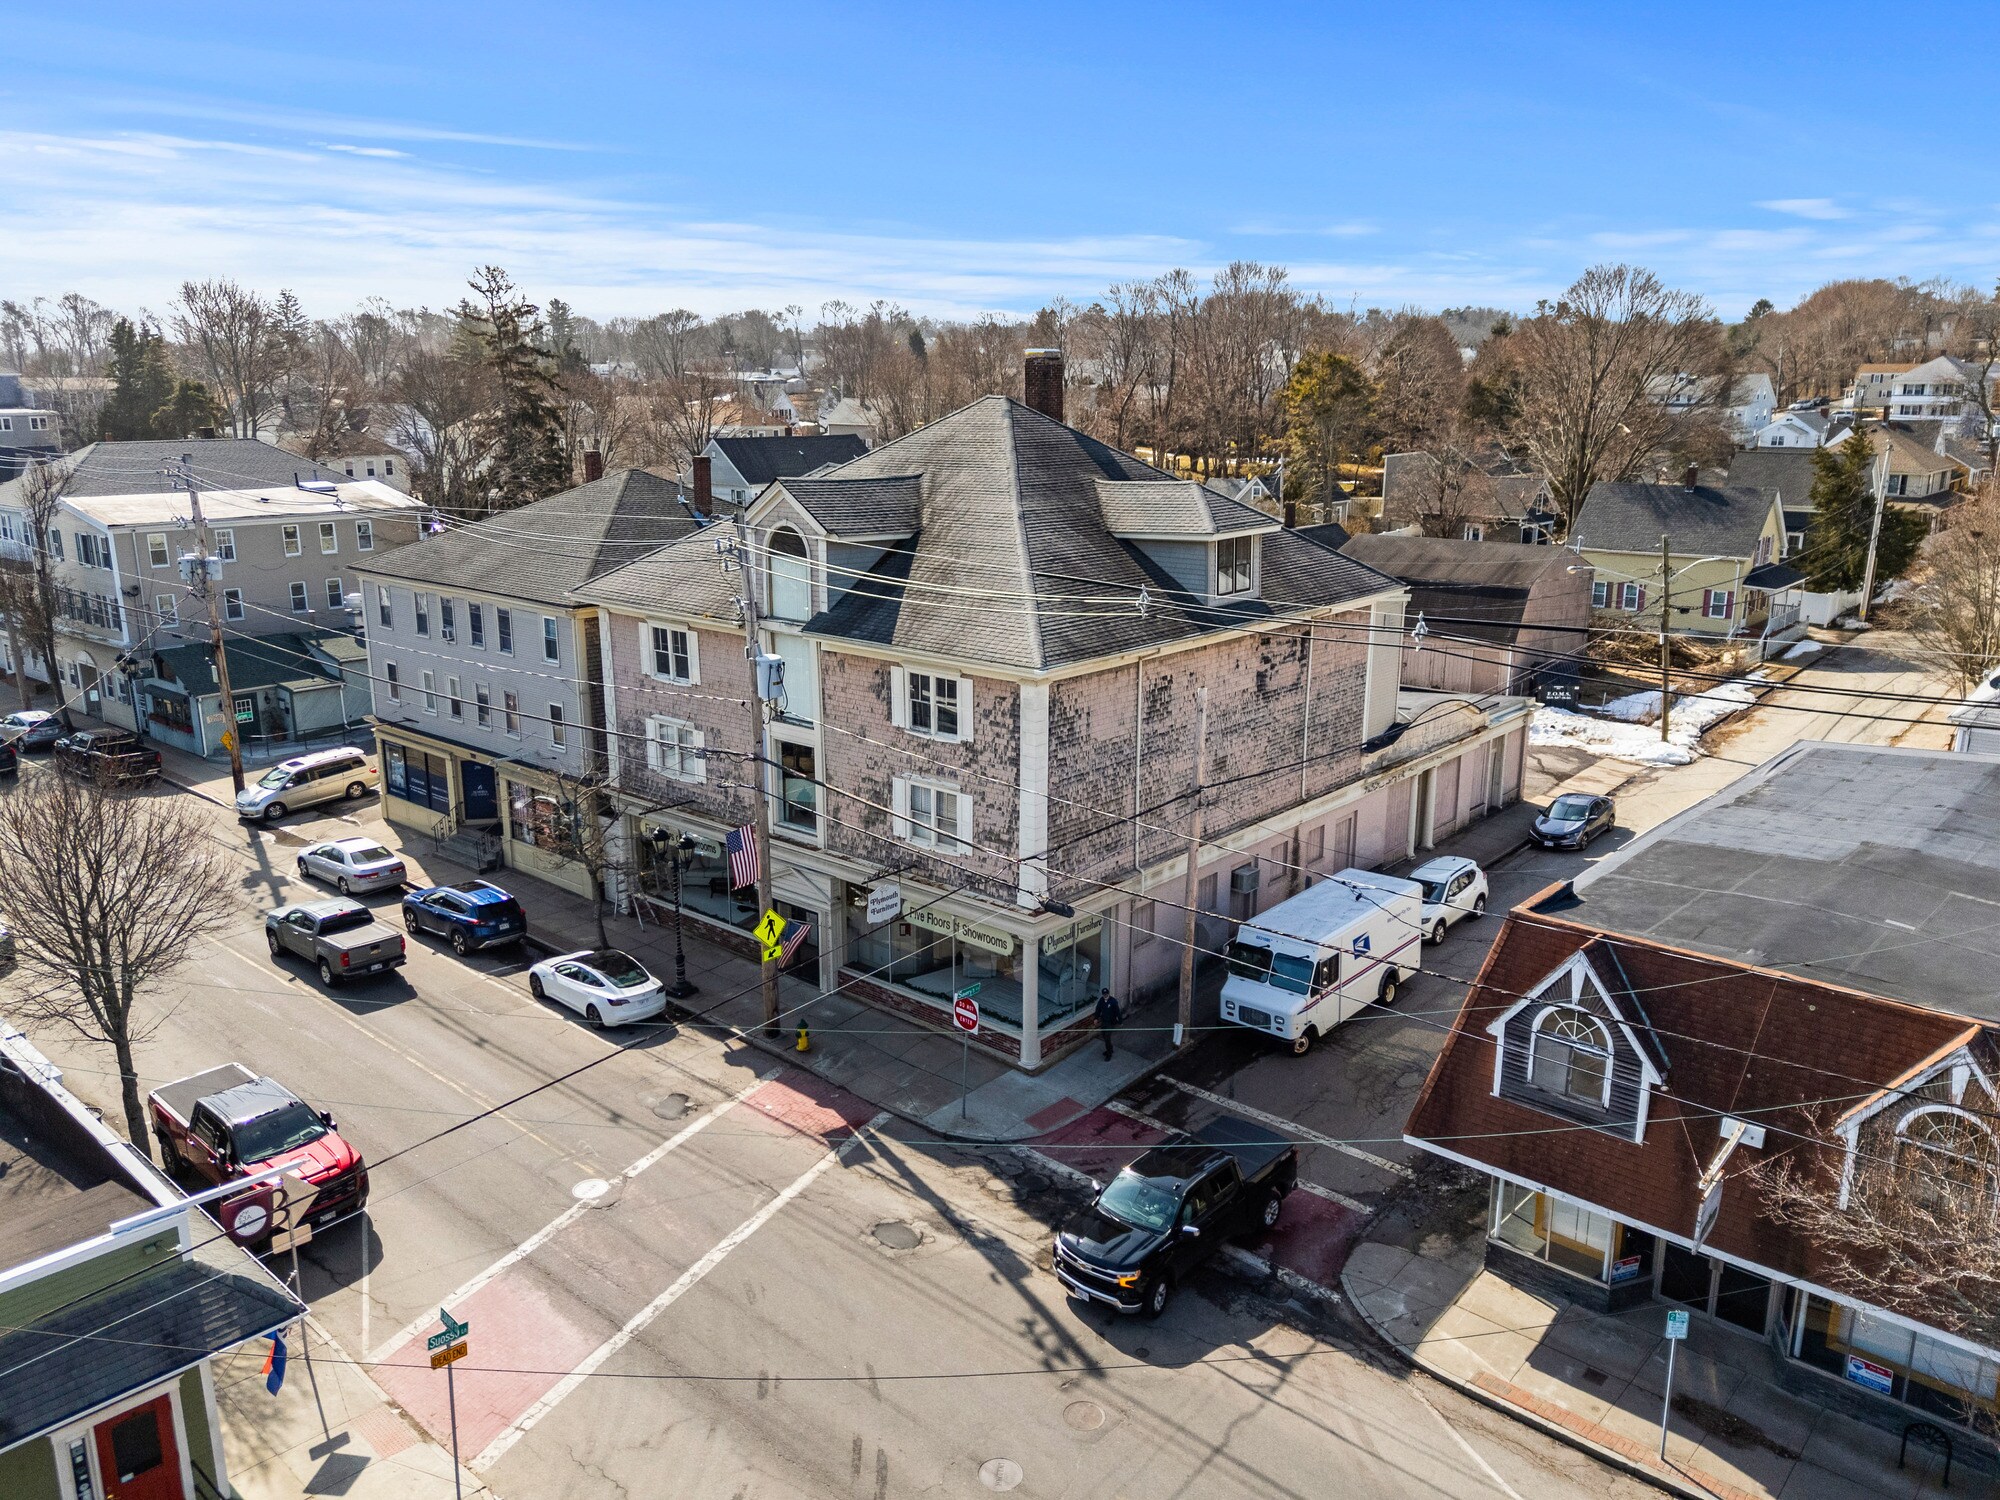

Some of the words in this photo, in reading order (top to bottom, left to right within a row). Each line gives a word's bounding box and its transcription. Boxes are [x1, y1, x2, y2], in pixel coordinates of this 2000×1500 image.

[870, 891, 898, 905] Plymouth
[871, 902, 898, 915] Furniture
[909, 906, 925, 922] Five
[926, 912, 951, 930] Floors
[962, 923, 1008, 950] Showrooms
[1044, 924, 1075, 953] Plymout
[1075, 917, 1103, 940] Furniture
[959, 1000, 966, 1008] DO
[966, 1004, 974, 1012] NOT
[959, 1015, 973, 1026] ENTER
[433, 1351, 451, 1367] DEAD
[452, 1345, 465, 1360] END
